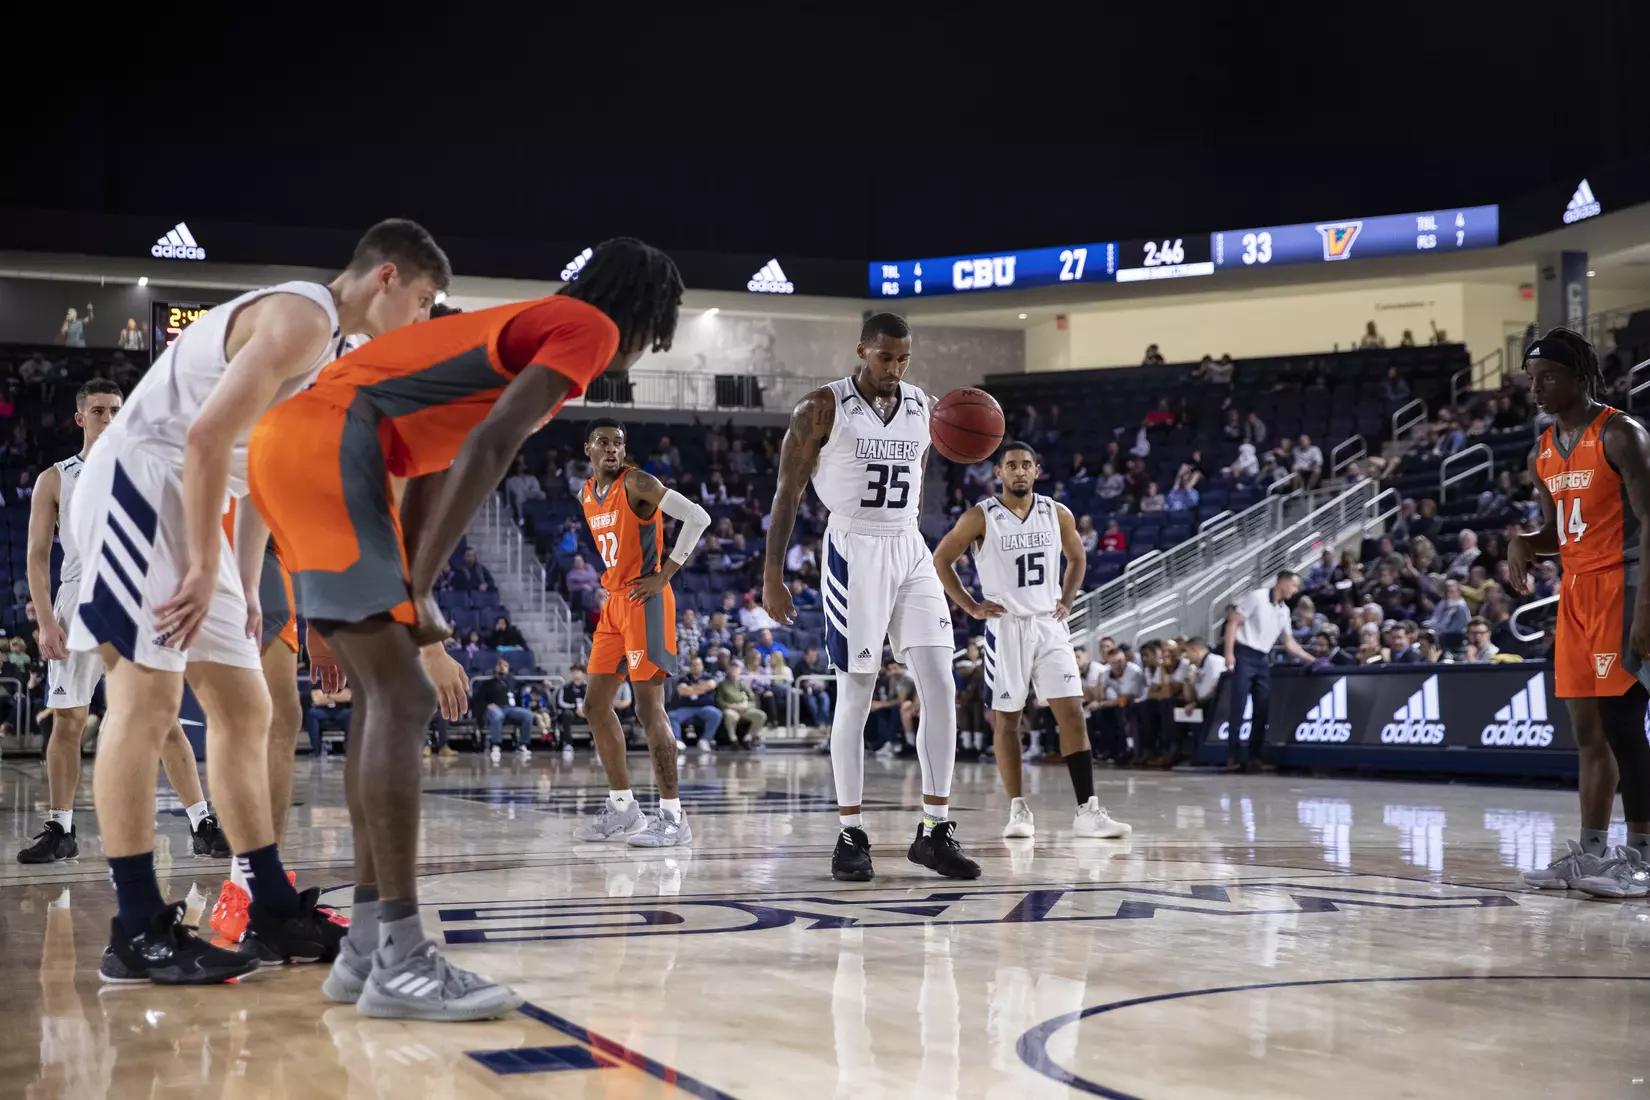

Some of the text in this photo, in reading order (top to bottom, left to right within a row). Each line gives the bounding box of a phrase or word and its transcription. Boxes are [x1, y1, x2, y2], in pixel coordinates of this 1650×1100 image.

[151, 244, 206, 260] adidas
[1143, 238, 1185, 267] 2:46
[1242, 232, 1272, 265] 33
[1456, 231, 1464, 247] 7
[882, 265, 900, 279] TOL
[952, 255, 1017, 290] CBU
[1059, 248, 1088, 281] 27
[747, 280, 795, 294] adidas
[855, 438, 919, 461] LANCERS
[860, 464, 910, 509] 35
[1545, 470, 1594, 495] UTRGV
[589, 510, 619, 530] UTRGV
[1556, 497, 1588, 547] 14
[597, 531, 619, 568] 22
[1001, 532, 1052, 551] LANCERS
[1015, 552, 1045, 588] 15
[1295, 717, 1352, 743] adidas
[1380, 717, 1446, 744] adidas
[1481, 718, 1555, 747] adidas
